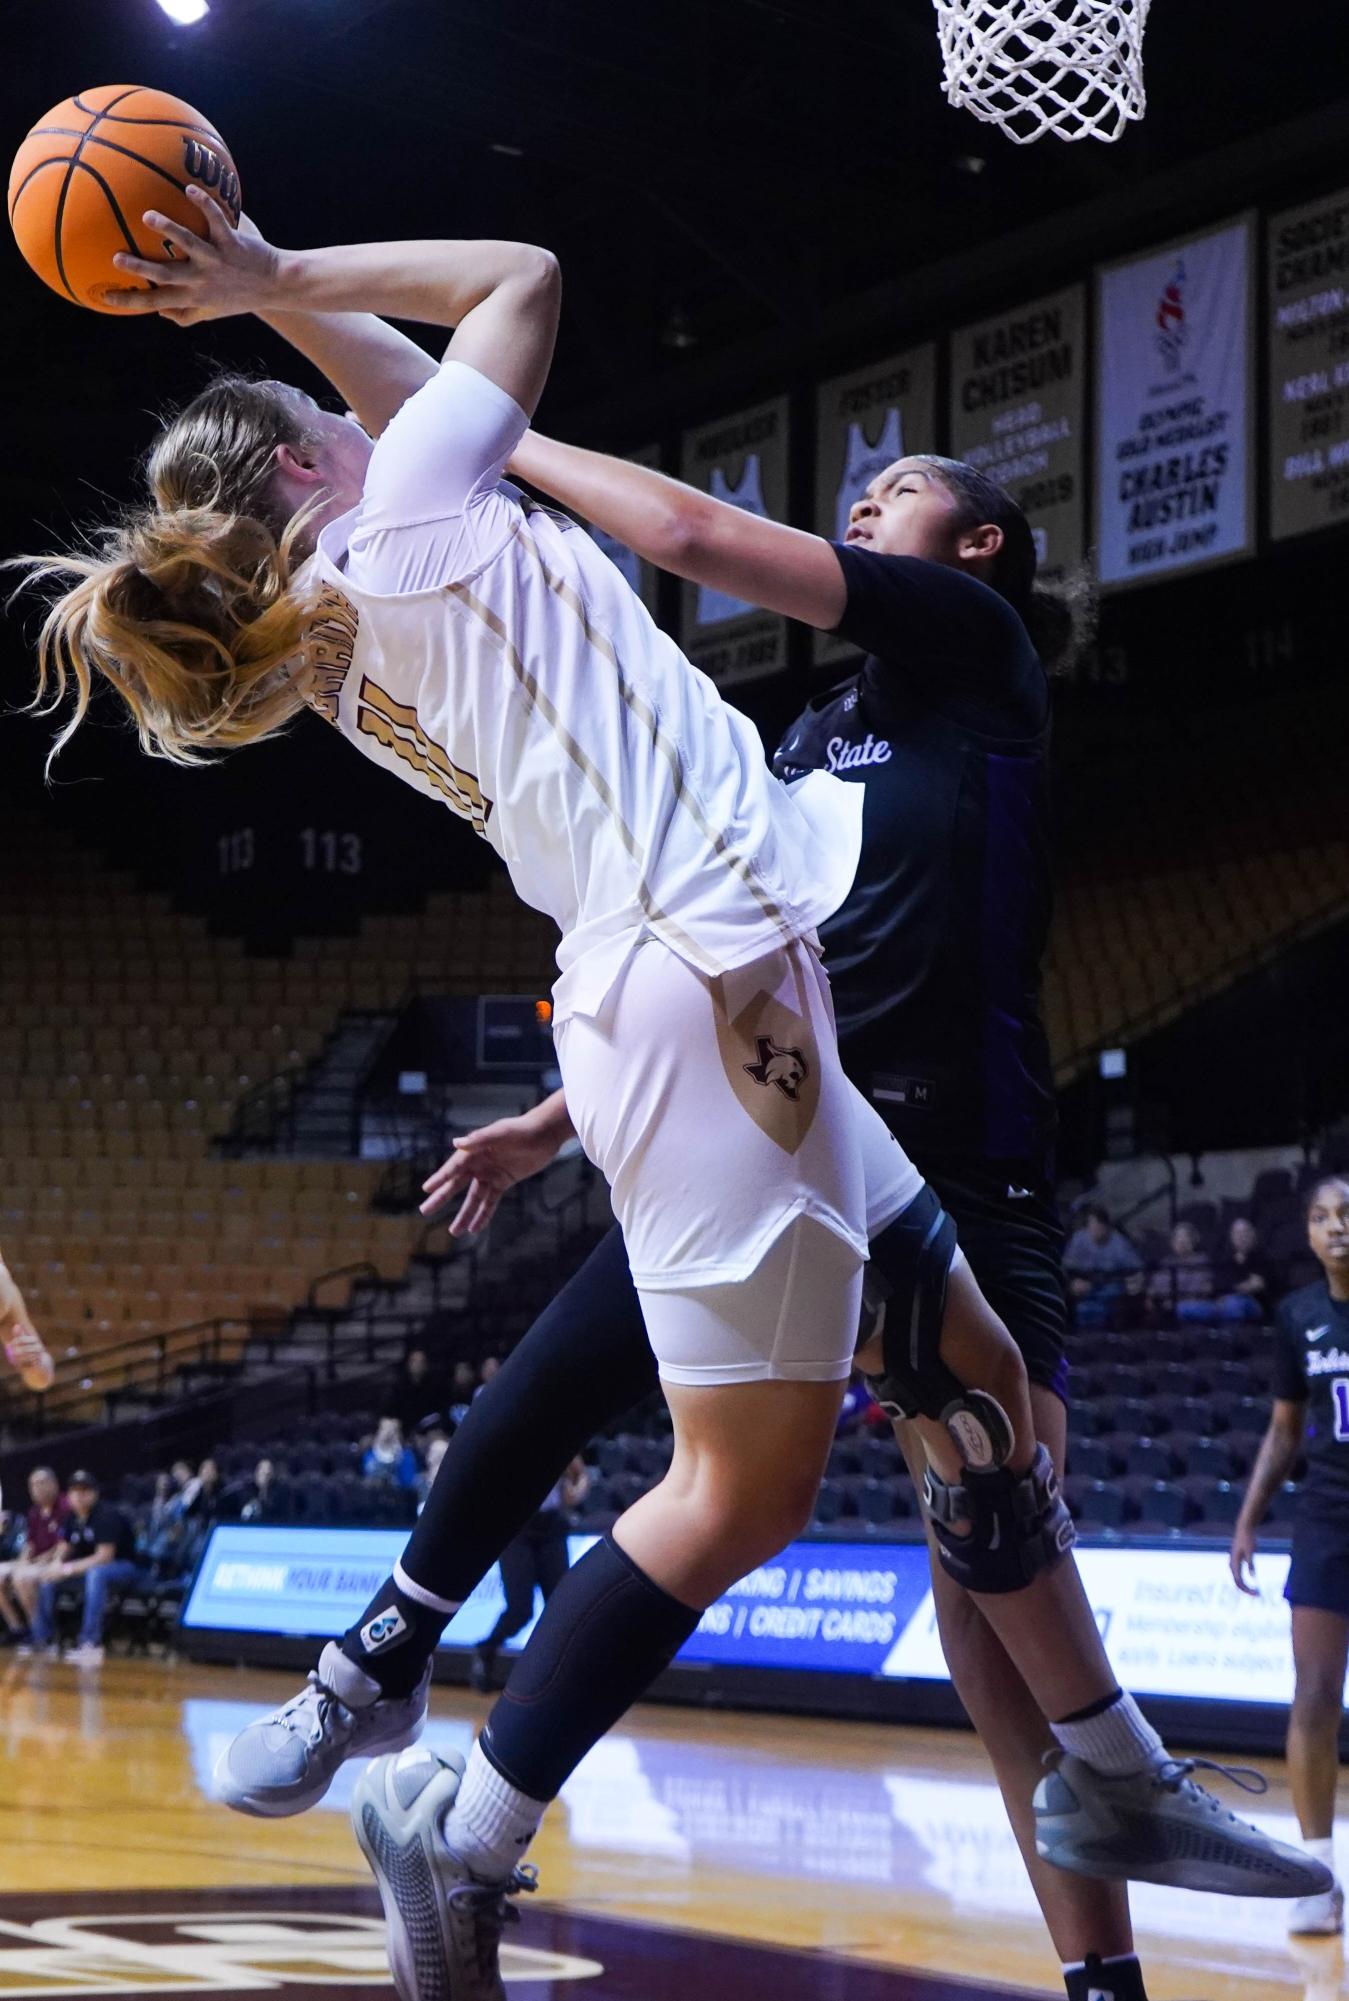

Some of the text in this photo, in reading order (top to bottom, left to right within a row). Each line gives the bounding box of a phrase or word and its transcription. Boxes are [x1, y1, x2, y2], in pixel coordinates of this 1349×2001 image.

[973, 309, 1061, 371] KAREN
[963, 343, 1072, 412] CHISUM
[1119, 441, 1229, 503] CHARLES
[1127, 480, 1220, 536] AUSTIN
[824, 733, 893, 774] State
[299, 826, 364, 876] 113
[803, 1568, 898, 1605] SAVINGS
[750, 1604, 824, 1640] CREDIT
[821, 1607, 897, 1645] CARDS
